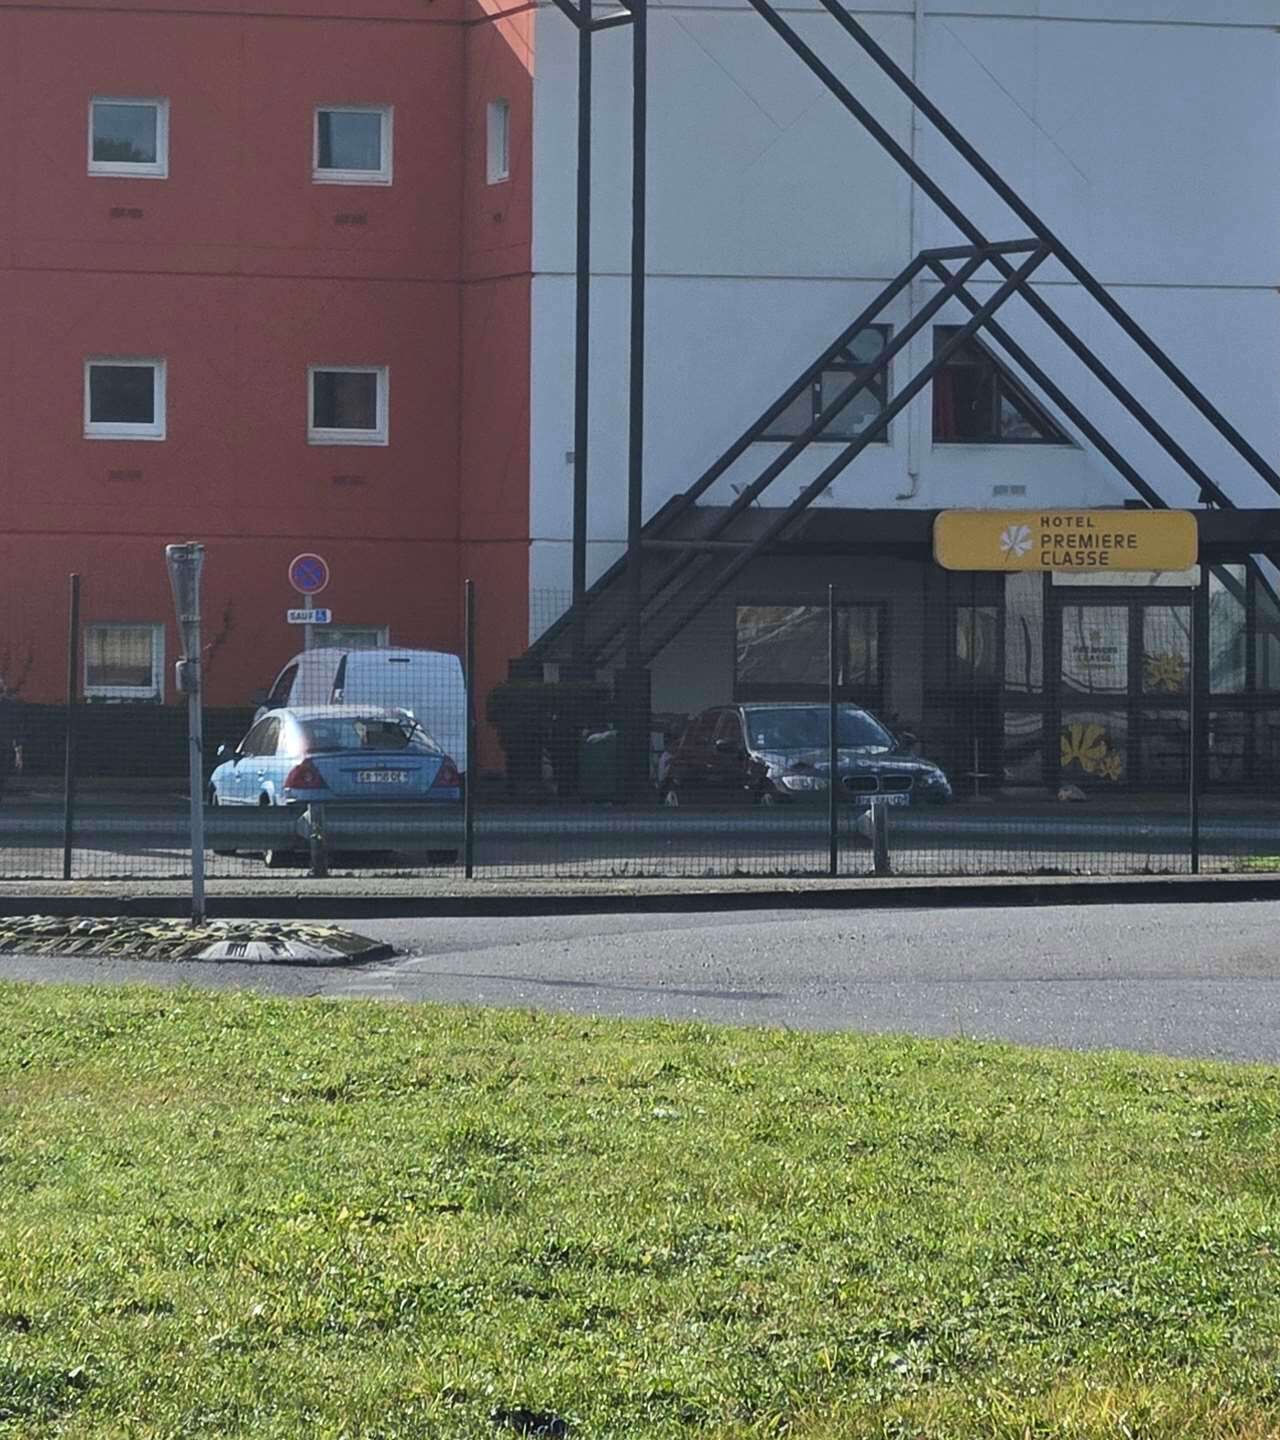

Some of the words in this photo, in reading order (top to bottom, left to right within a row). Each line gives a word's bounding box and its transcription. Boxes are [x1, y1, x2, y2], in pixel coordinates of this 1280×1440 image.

[1040, 516, 1095, 528] HOTEL
[1040, 534, 1137, 549] PREMIERE
[1040, 550, 1109, 566] CLASSE
[289, 611, 314, 620] SAUF
